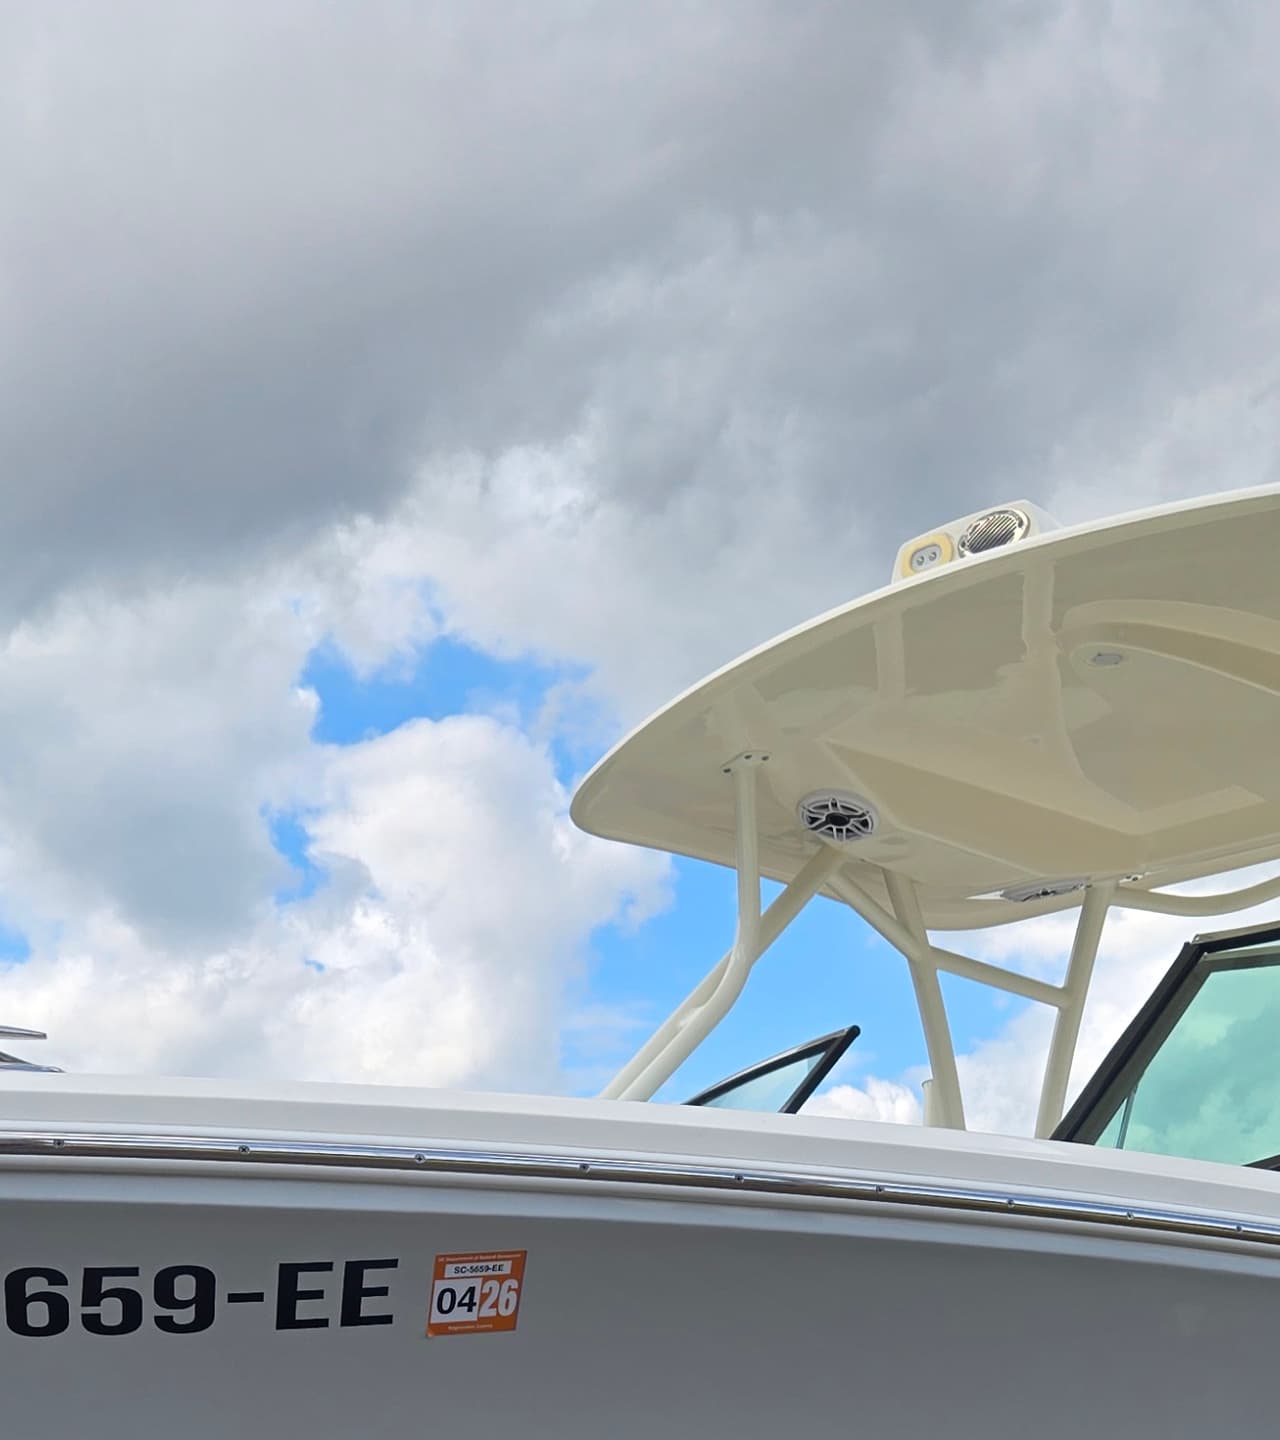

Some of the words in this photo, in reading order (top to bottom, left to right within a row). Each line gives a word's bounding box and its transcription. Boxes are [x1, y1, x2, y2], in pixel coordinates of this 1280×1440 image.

[453, 1263, 505, 1275] SC-5659-EE
[436, 1286, 477, 1315] 04
[478, 1278, 519, 1318] 26
